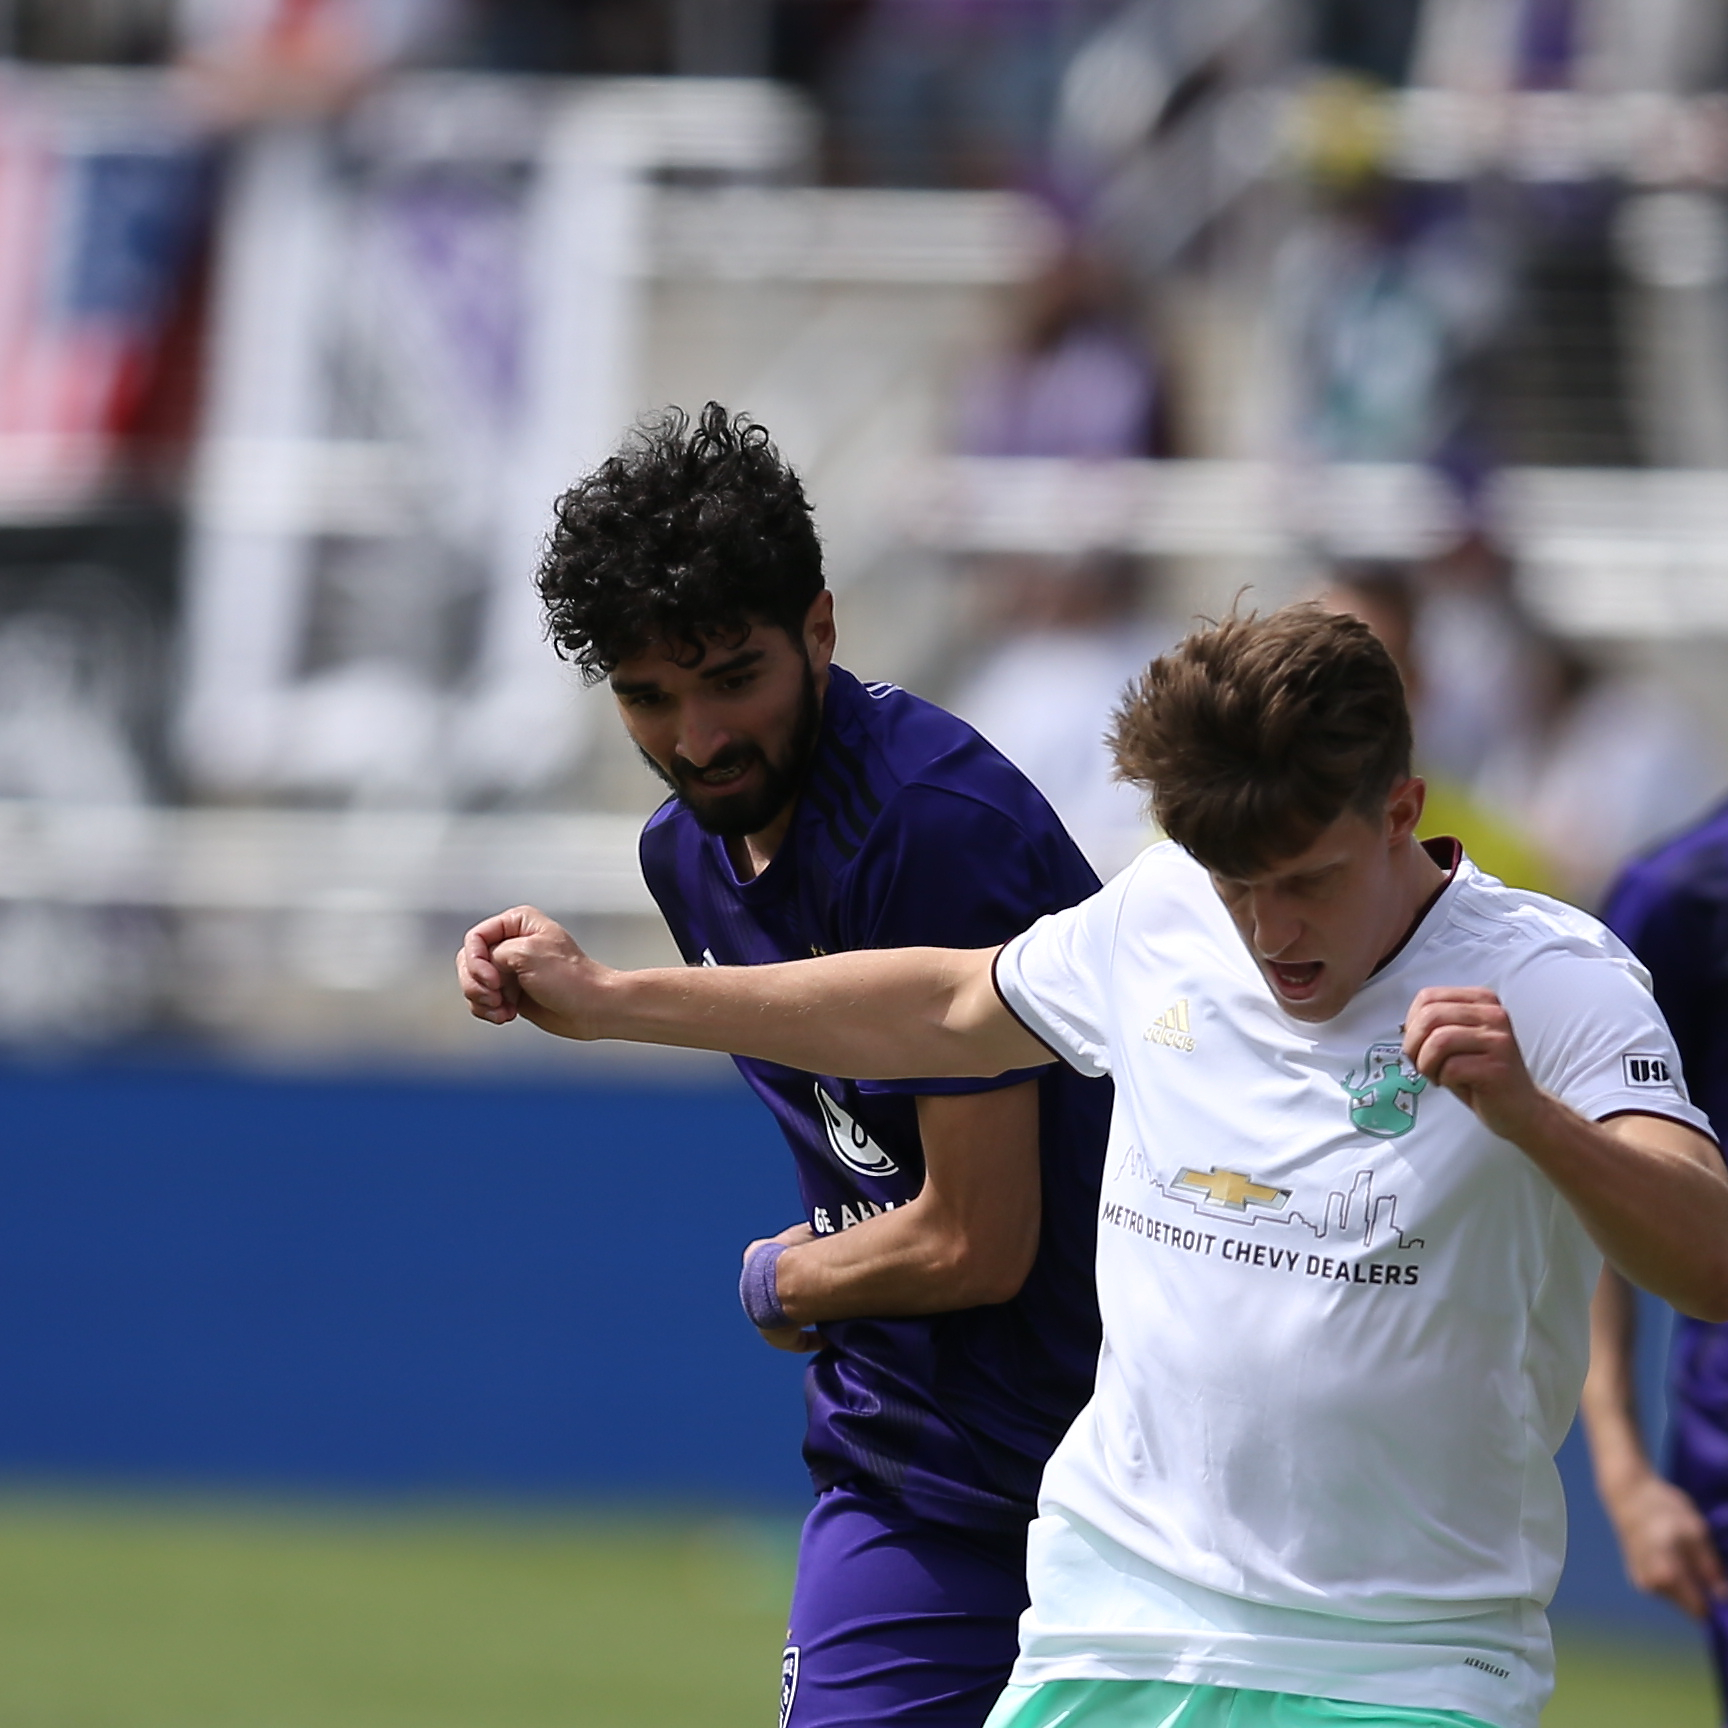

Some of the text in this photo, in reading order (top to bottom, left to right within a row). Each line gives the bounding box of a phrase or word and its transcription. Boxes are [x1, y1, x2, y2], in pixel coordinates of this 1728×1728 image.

[813, 1206, 836, 1234] GE
[1101, 1201, 1420, 1287] METRO DETROIT CHEVY DEALERS
